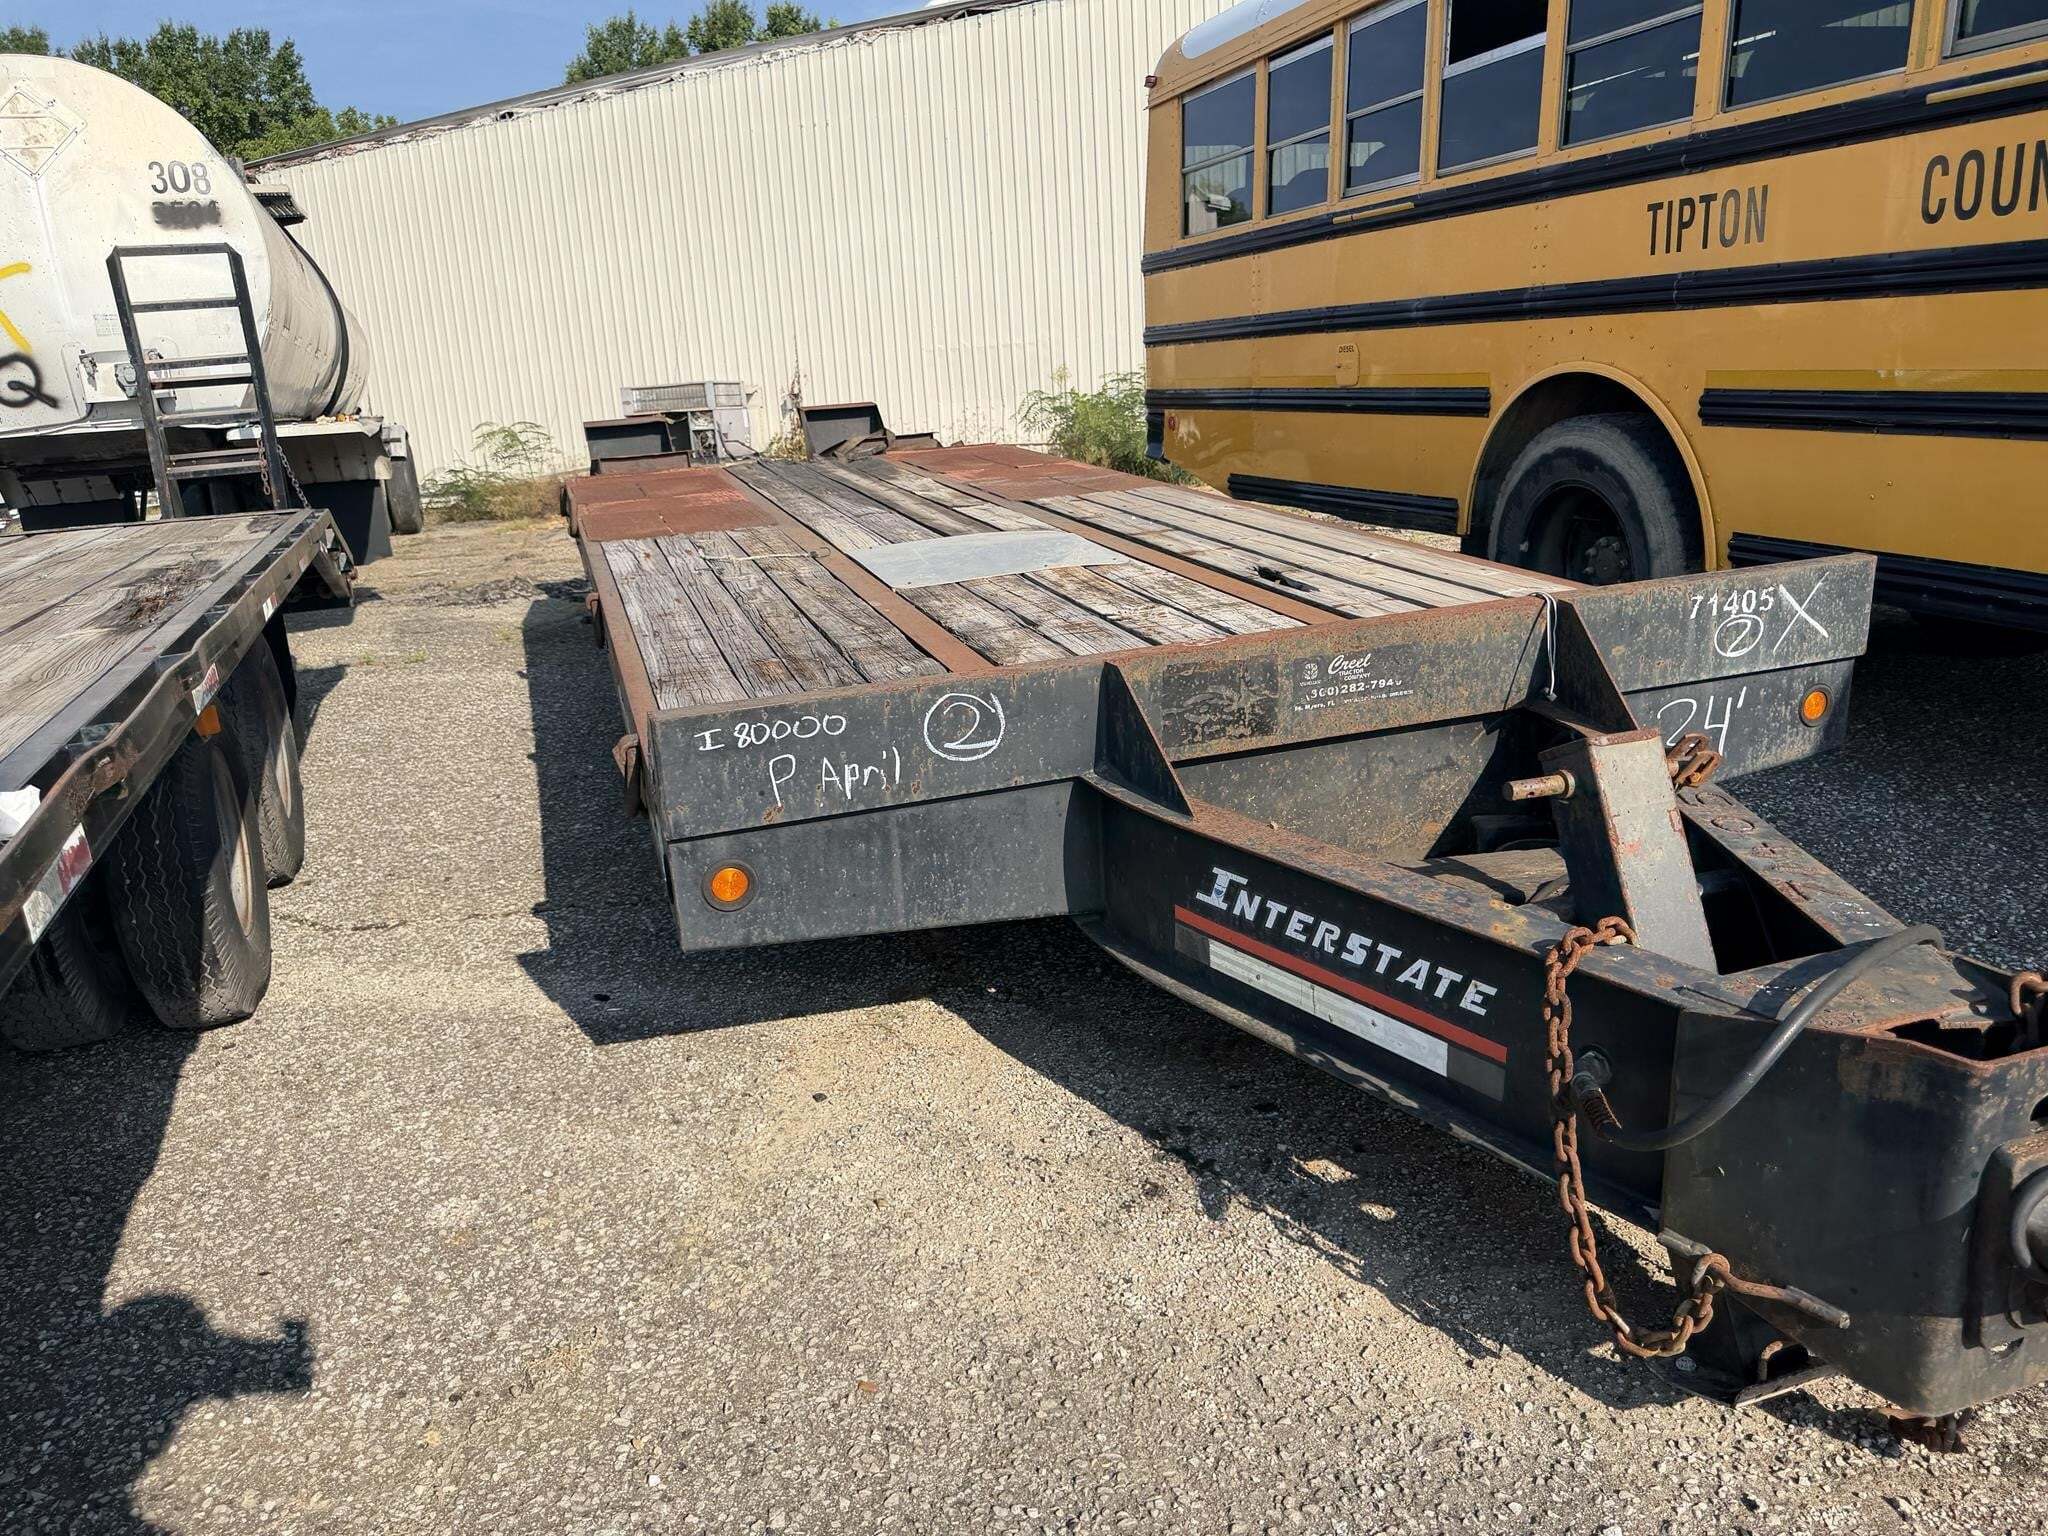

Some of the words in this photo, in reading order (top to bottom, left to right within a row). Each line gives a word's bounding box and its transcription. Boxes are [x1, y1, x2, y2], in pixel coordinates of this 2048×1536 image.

[148, 160, 211, 195] 308
[1647, 184, 1769, 256] TIPTON
[1690, 586, 1774, 619] 71405
[1328, 653, 1372, 675] Creel
[733, 714, 847, 748] 80000
[821, 744, 900, 800] April
[1196, 866, 1498, 1016] INTERSTATE
